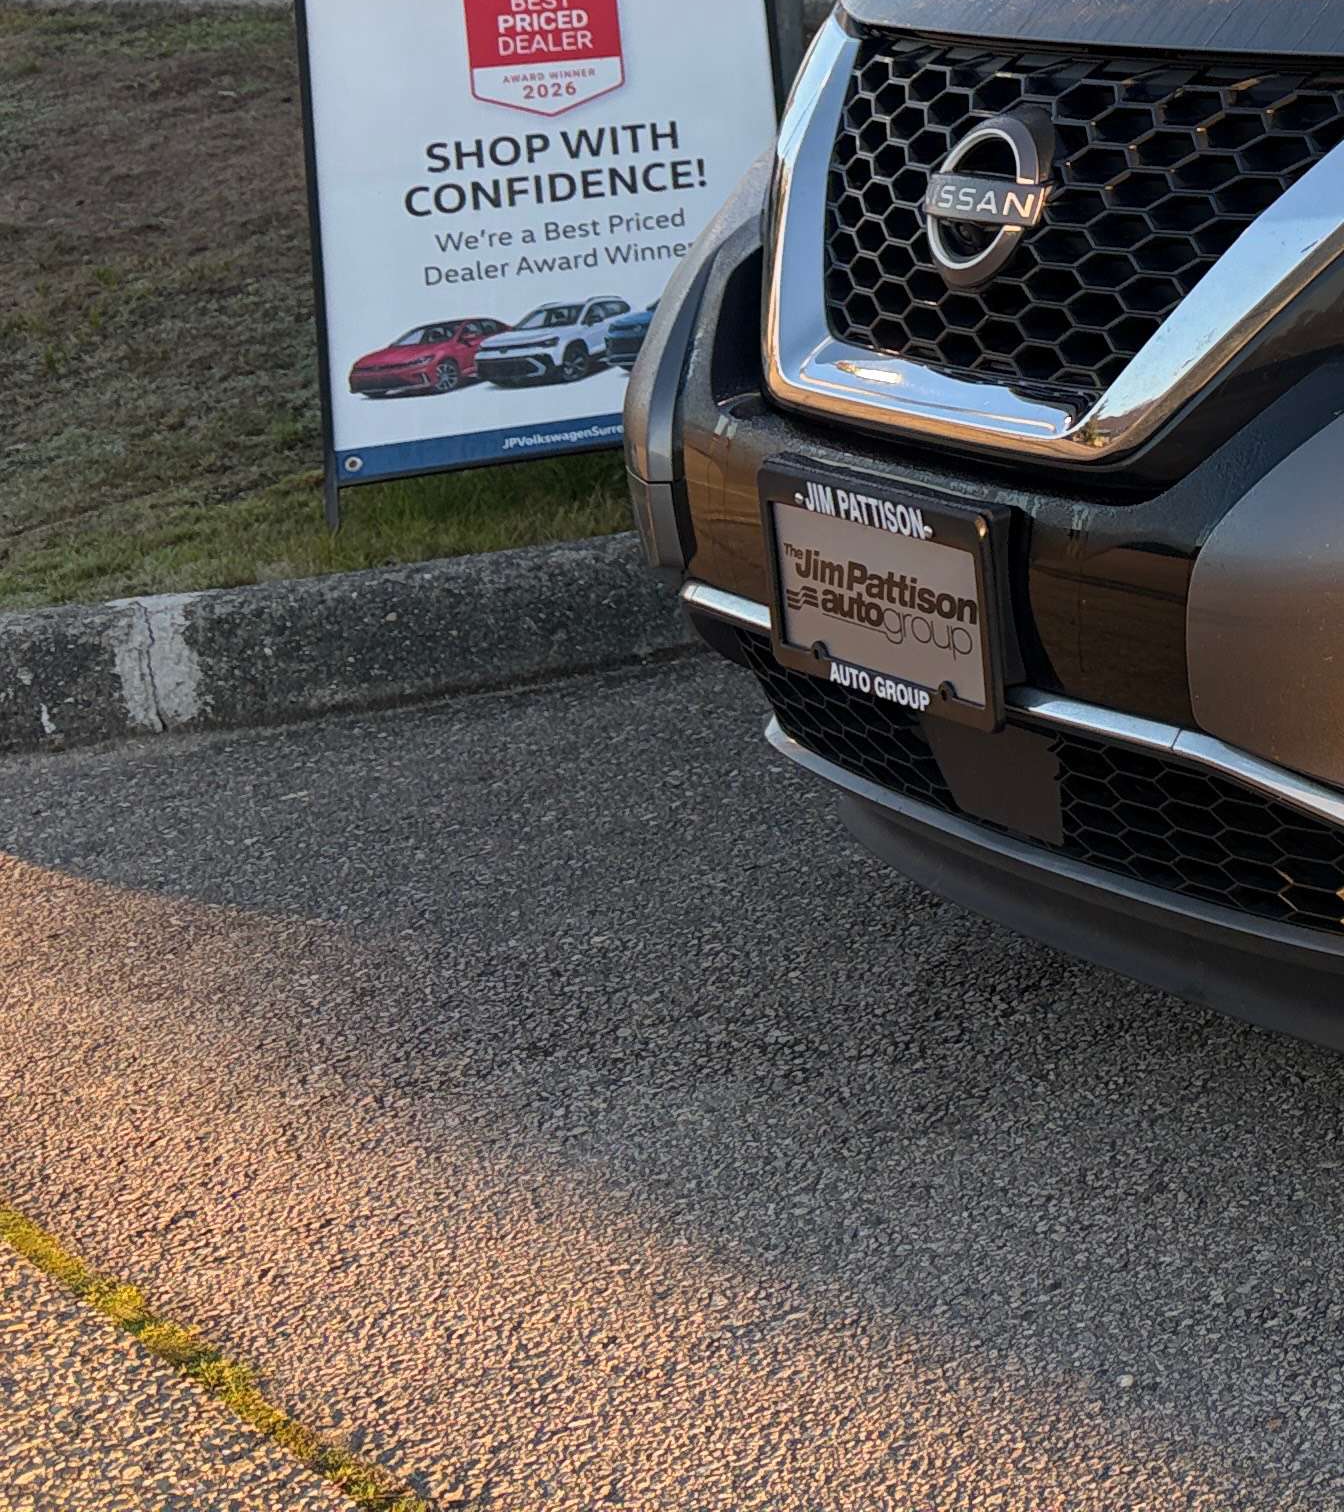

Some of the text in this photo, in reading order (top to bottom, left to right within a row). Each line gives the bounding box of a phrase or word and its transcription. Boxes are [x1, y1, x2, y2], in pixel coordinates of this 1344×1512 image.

[497, 9, 589, 33] PRICED
[497, 30, 593, 56] DEALER
[503, 68, 596, 84] AWARD WINNER
[522, 82, 577, 99] 2026
[425, 120, 679, 173] SHOP WITH
[404, 158, 707, 217] CONFIDENCE!
[434, 207, 686, 253] We're a Best Priced
[424, 241, 693, 286] Dealer Award Winne
[804, 481, 927, 540] JIM PATTISON
[783, 543, 804, 560] The
[829, 662, 931, 711] AUTO GROUP
